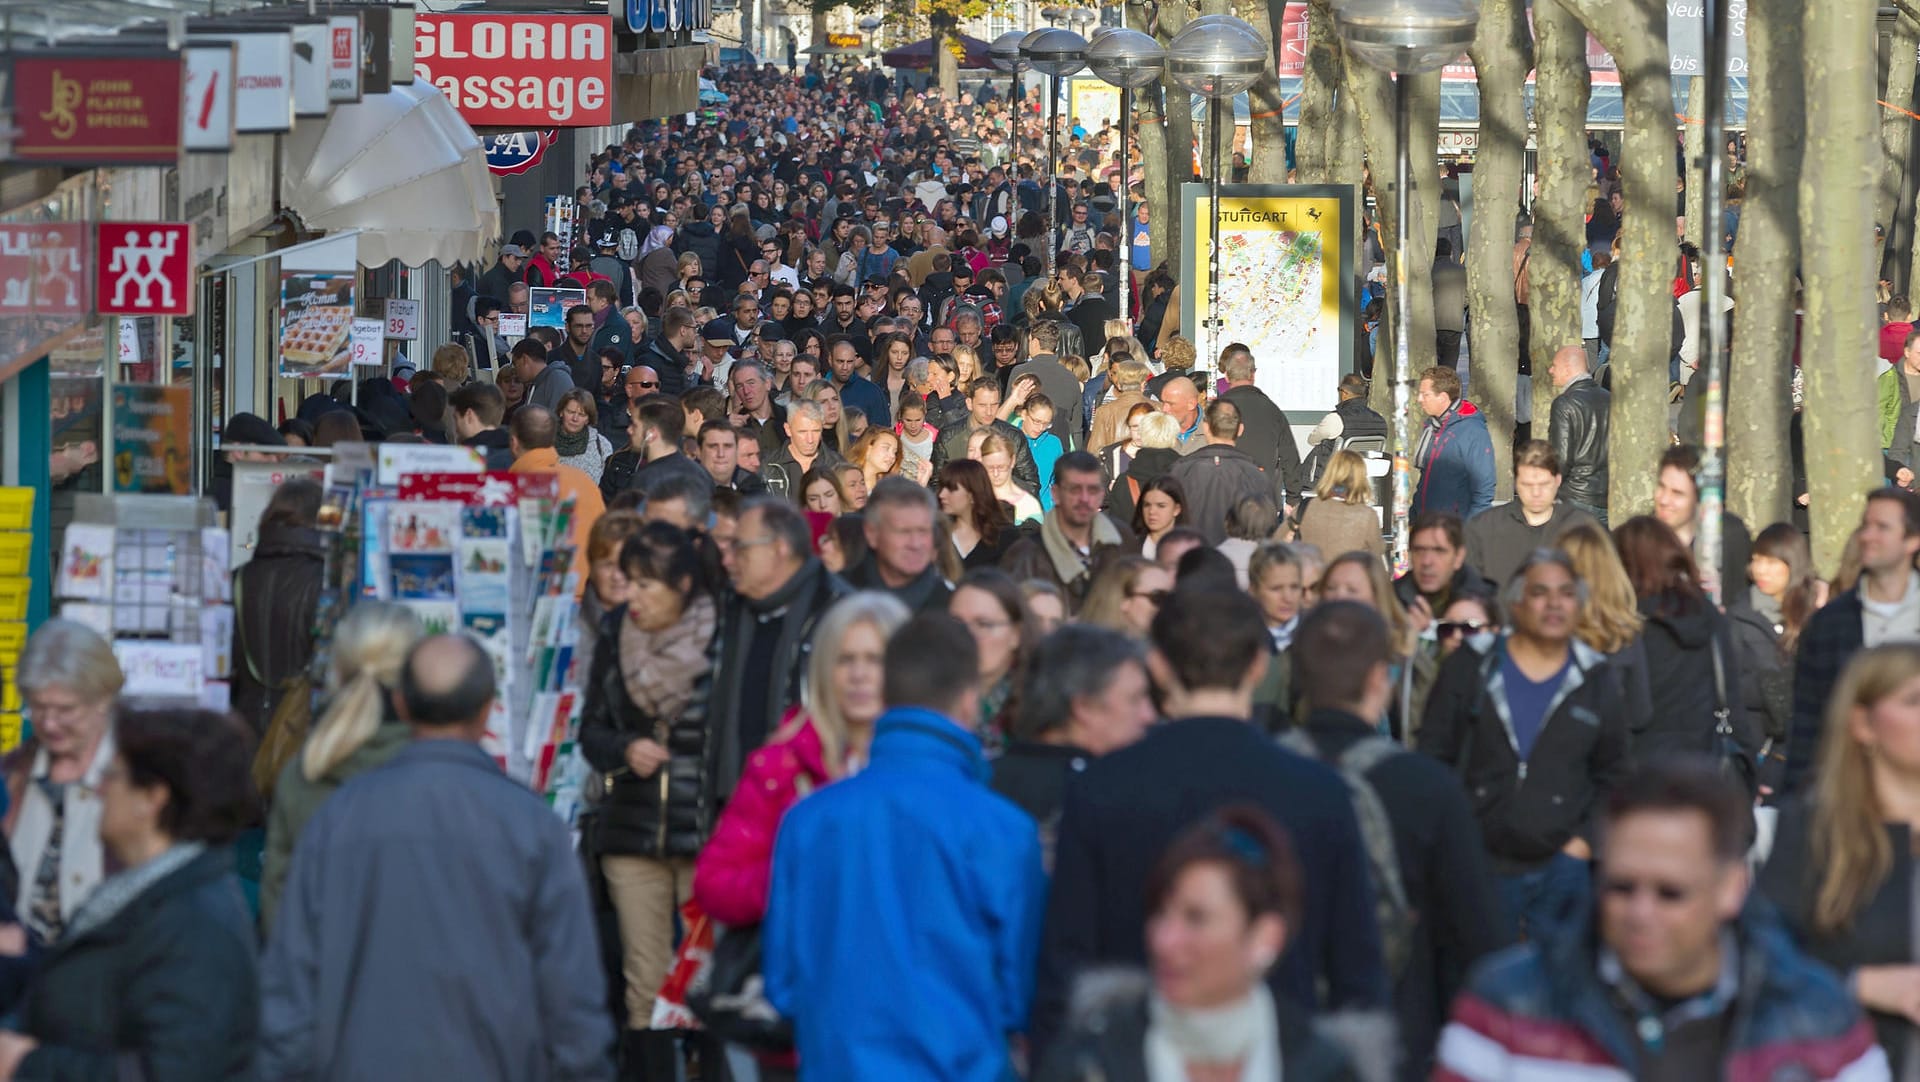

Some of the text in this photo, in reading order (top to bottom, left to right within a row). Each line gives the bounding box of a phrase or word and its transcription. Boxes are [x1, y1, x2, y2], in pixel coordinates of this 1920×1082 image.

[415, 21, 605, 60] GLORIA
[1670, 54, 1697, 71] bis
[87, 79, 134, 94] JOHN
[86, 95, 143, 111] PLAYER
[86, 112, 149, 128] SPECIAL
[389, 318, 416, 337] 39,-
